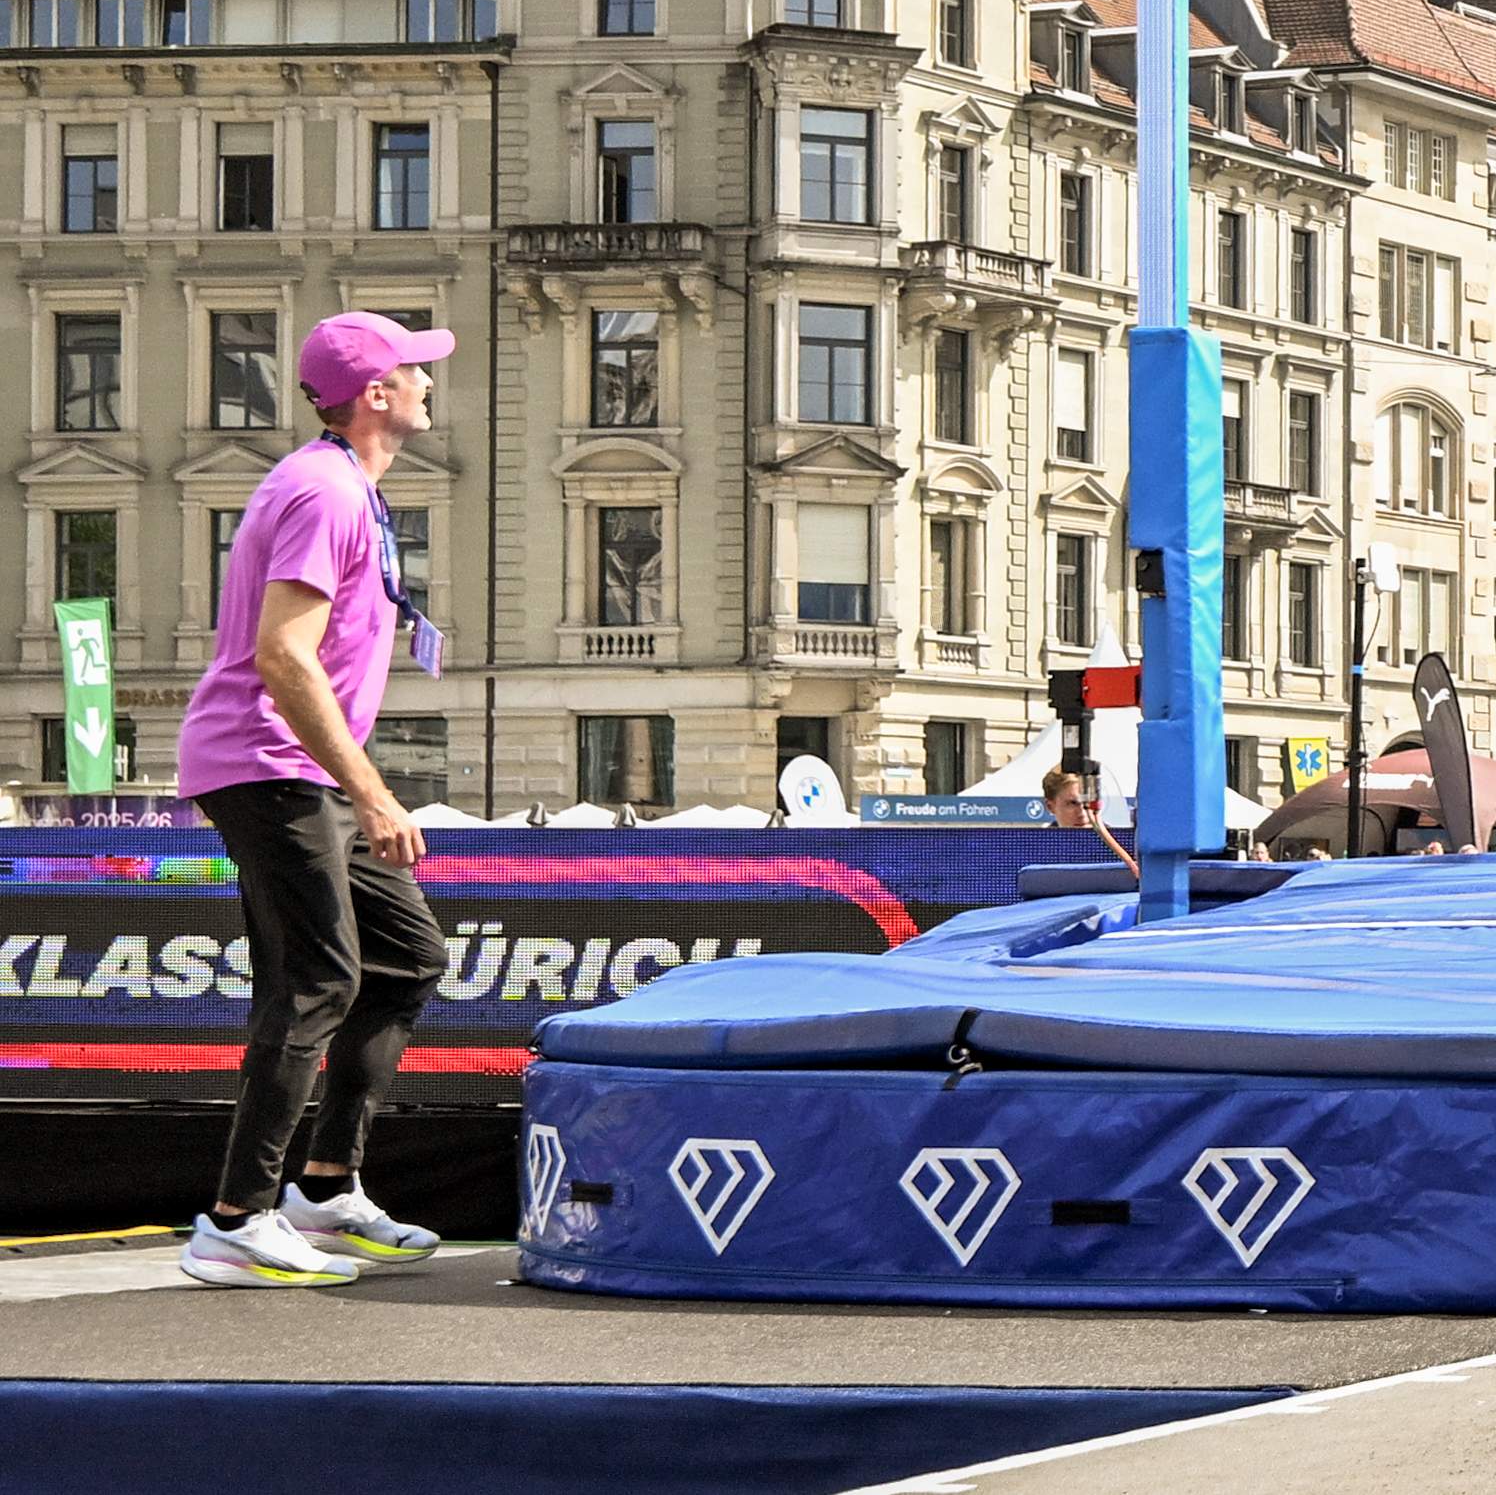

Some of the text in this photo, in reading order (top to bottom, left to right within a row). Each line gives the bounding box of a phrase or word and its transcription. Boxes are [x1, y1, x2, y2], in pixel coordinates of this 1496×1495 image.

[895, 802, 999, 816] Freude am Fahren
